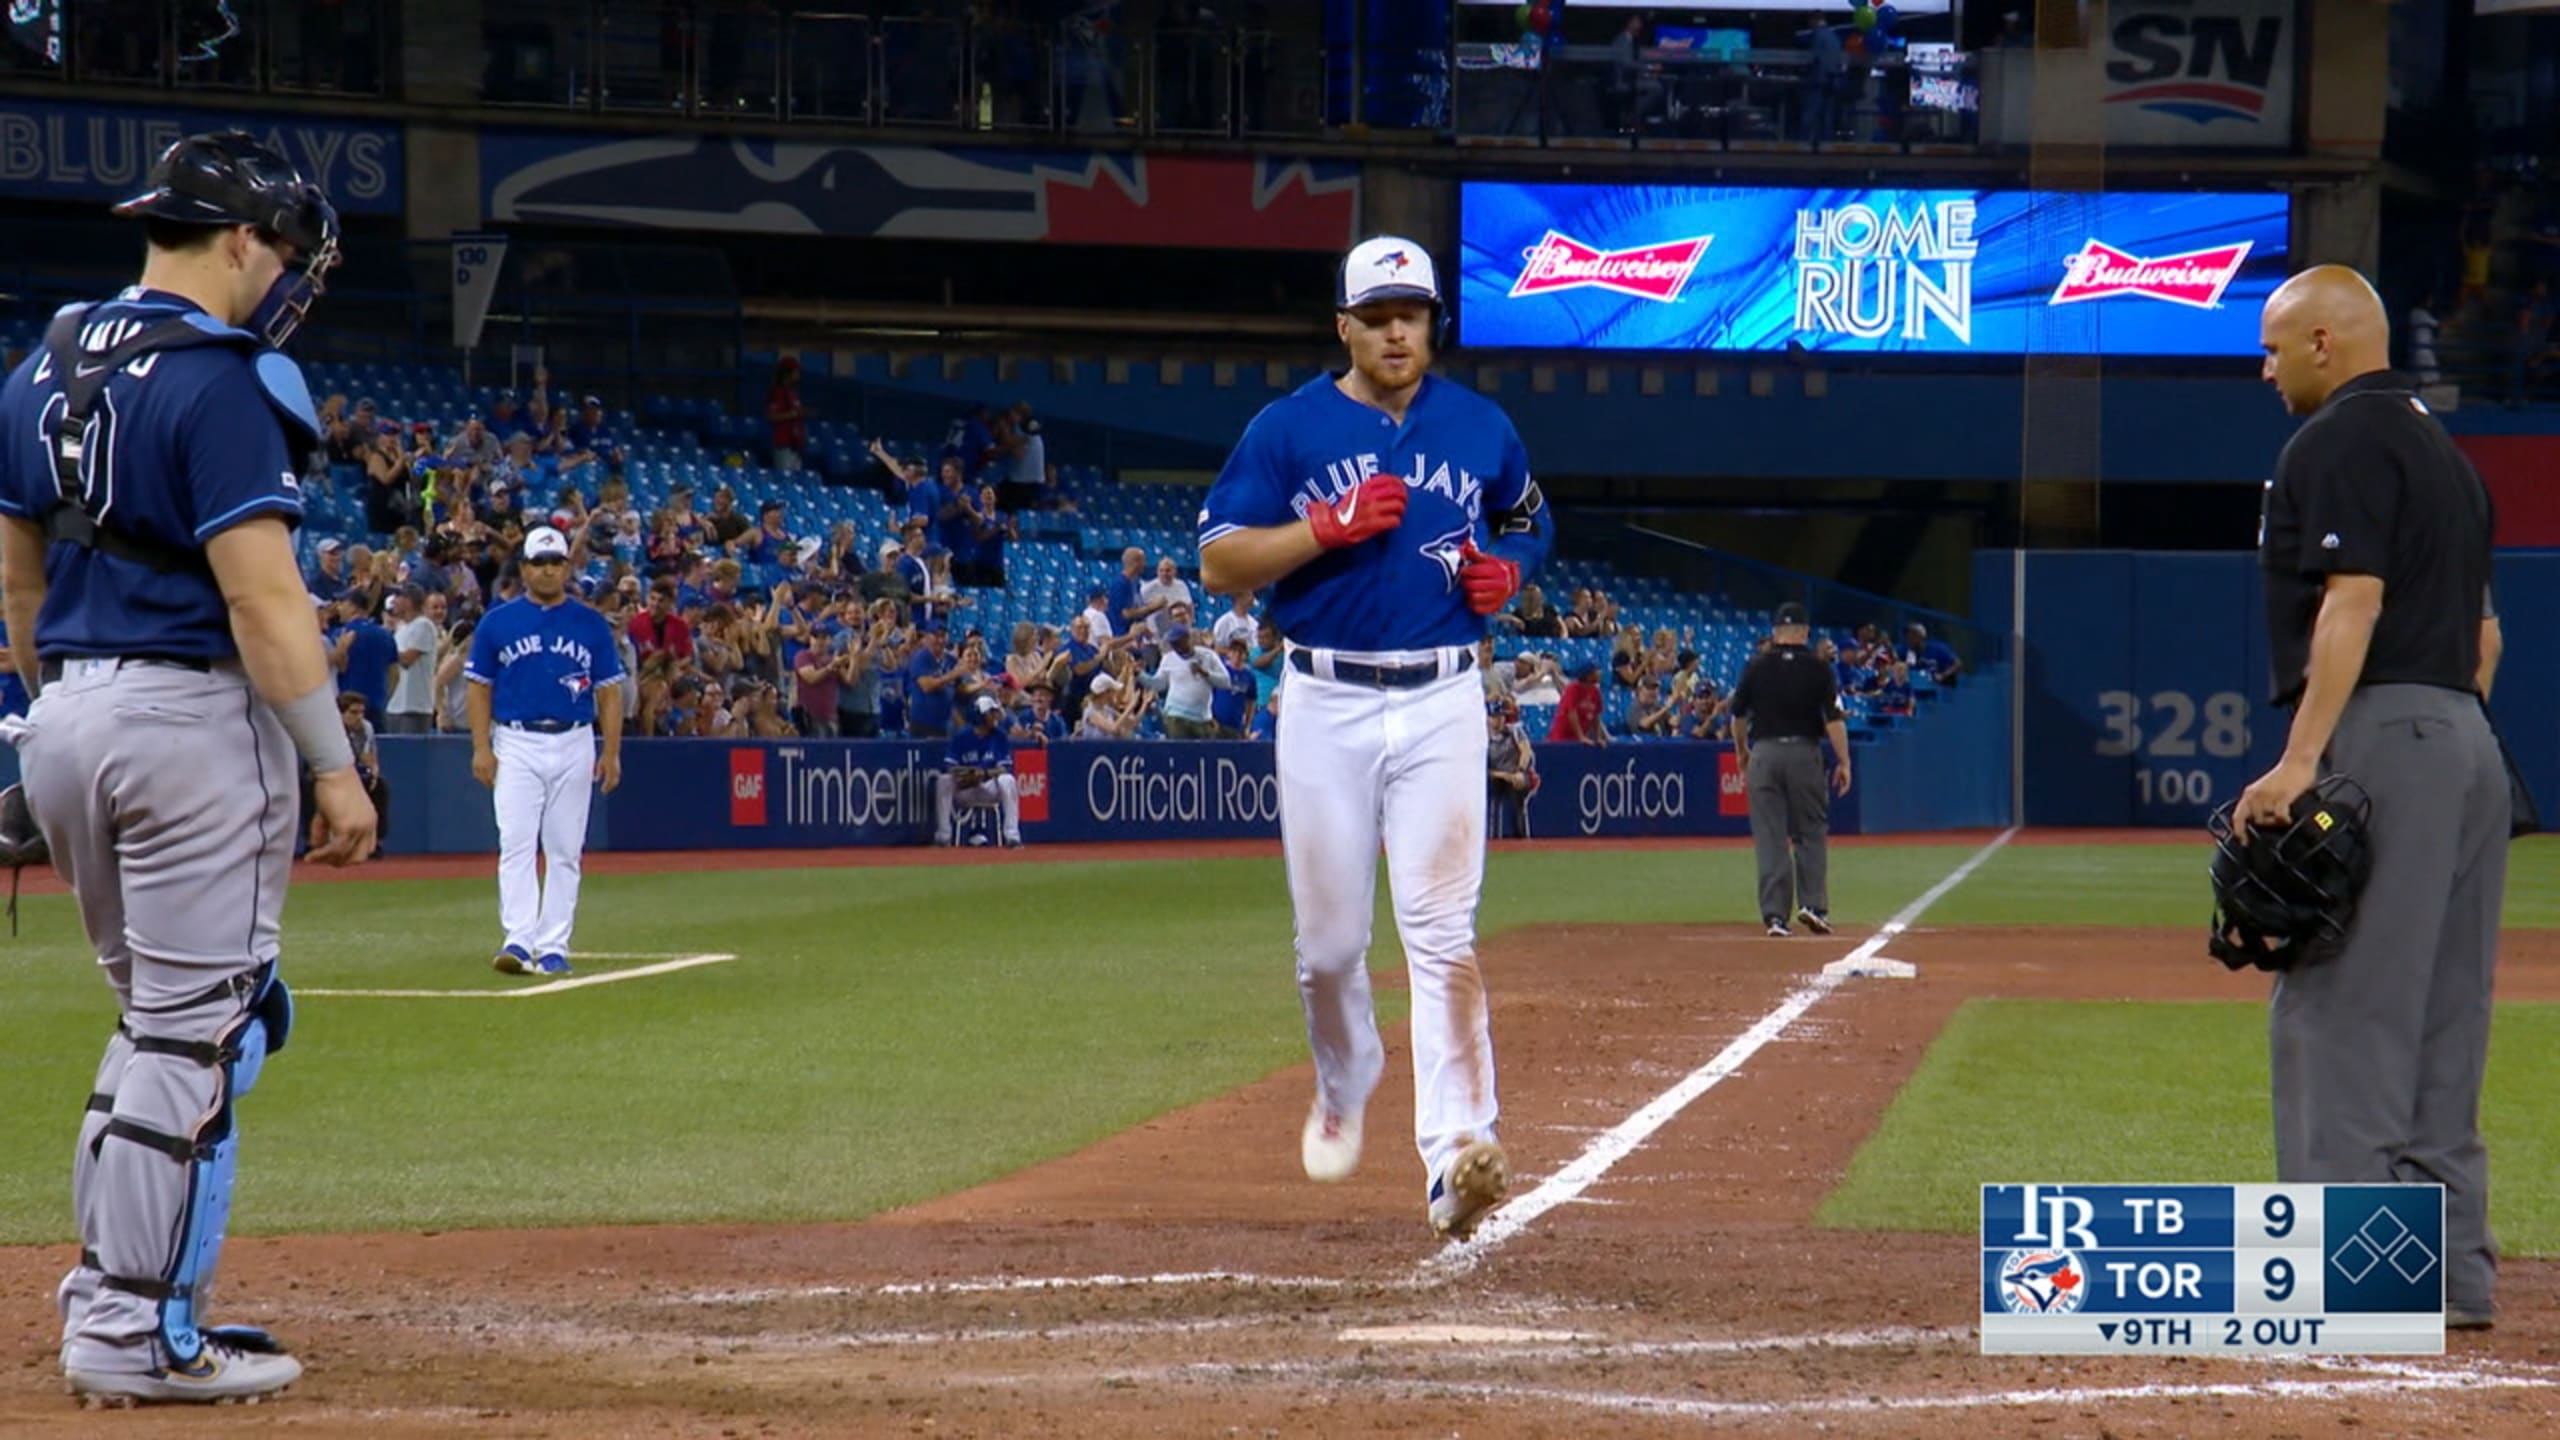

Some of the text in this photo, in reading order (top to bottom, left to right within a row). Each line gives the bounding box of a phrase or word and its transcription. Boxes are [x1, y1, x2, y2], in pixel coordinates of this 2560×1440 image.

[2105, 12, 2282, 88] SN
[458, 247, 488, 266] 130
[1794, 199, 1979, 259] HOME
[1522, 245, 1695, 280] Budweiser
[2063, 253, 2229, 286] Budweiser
[1794, 258, 1972, 346] RUN
[1403, 453, 1484, 520] JAYS
[498, 634, 592, 669] BLUE JAYS
[2096, 690, 2252, 758] 328
[734, 774, 763, 798] GAF
[1087, 755, 1206, 822] Official
[1579, 757, 1685, 834] gaf.ca
[2136, 769, 2211, 804] 100
